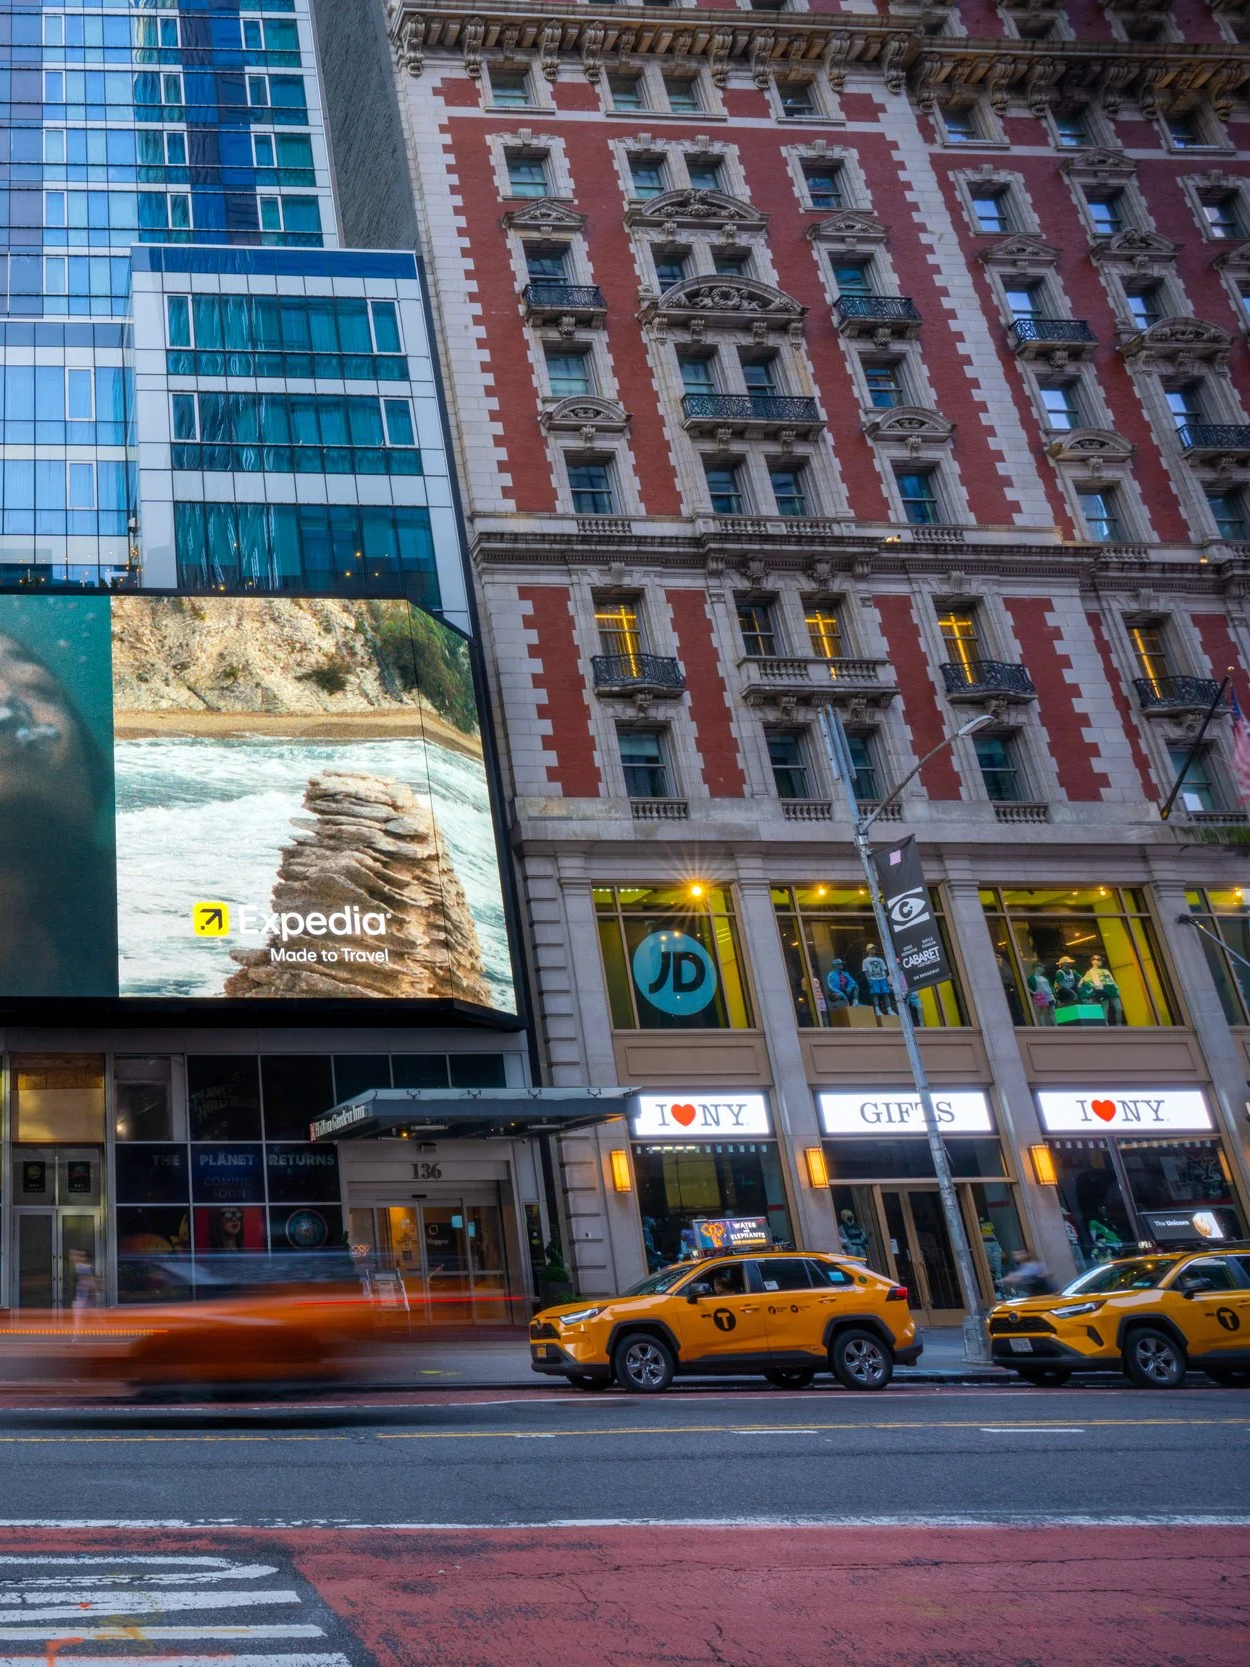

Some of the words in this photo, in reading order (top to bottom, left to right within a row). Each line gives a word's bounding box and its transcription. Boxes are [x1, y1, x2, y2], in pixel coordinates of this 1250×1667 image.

[238, 905, 386, 941] Expedia
[270, 948, 317, 962] Made
[321, 949, 338, 962] to
[341, 948, 389, 962] Travel
[902, 946, 939, 968] CABARET
[648, 951, 706, 994] JD
[655, 1104, 672, 1127] I
[699, 1103, 749, 1127] NY
[1076, 1099, 1093, 1122] I
[1117, 1100, 1165, 1122] NY
[152, 1154, 180, 1166] THE
[199, 1153, 254, 1166] PLANET
[268, 1154, 335, 1166] RETURNS
[410, 1163, 442, 1180] 136
[204, 1176, 253, 1186] COMING
[1166, 1219, 1190, 1227] Unicorn
[730, 1232, 766, 1240] ELEPHANTS
